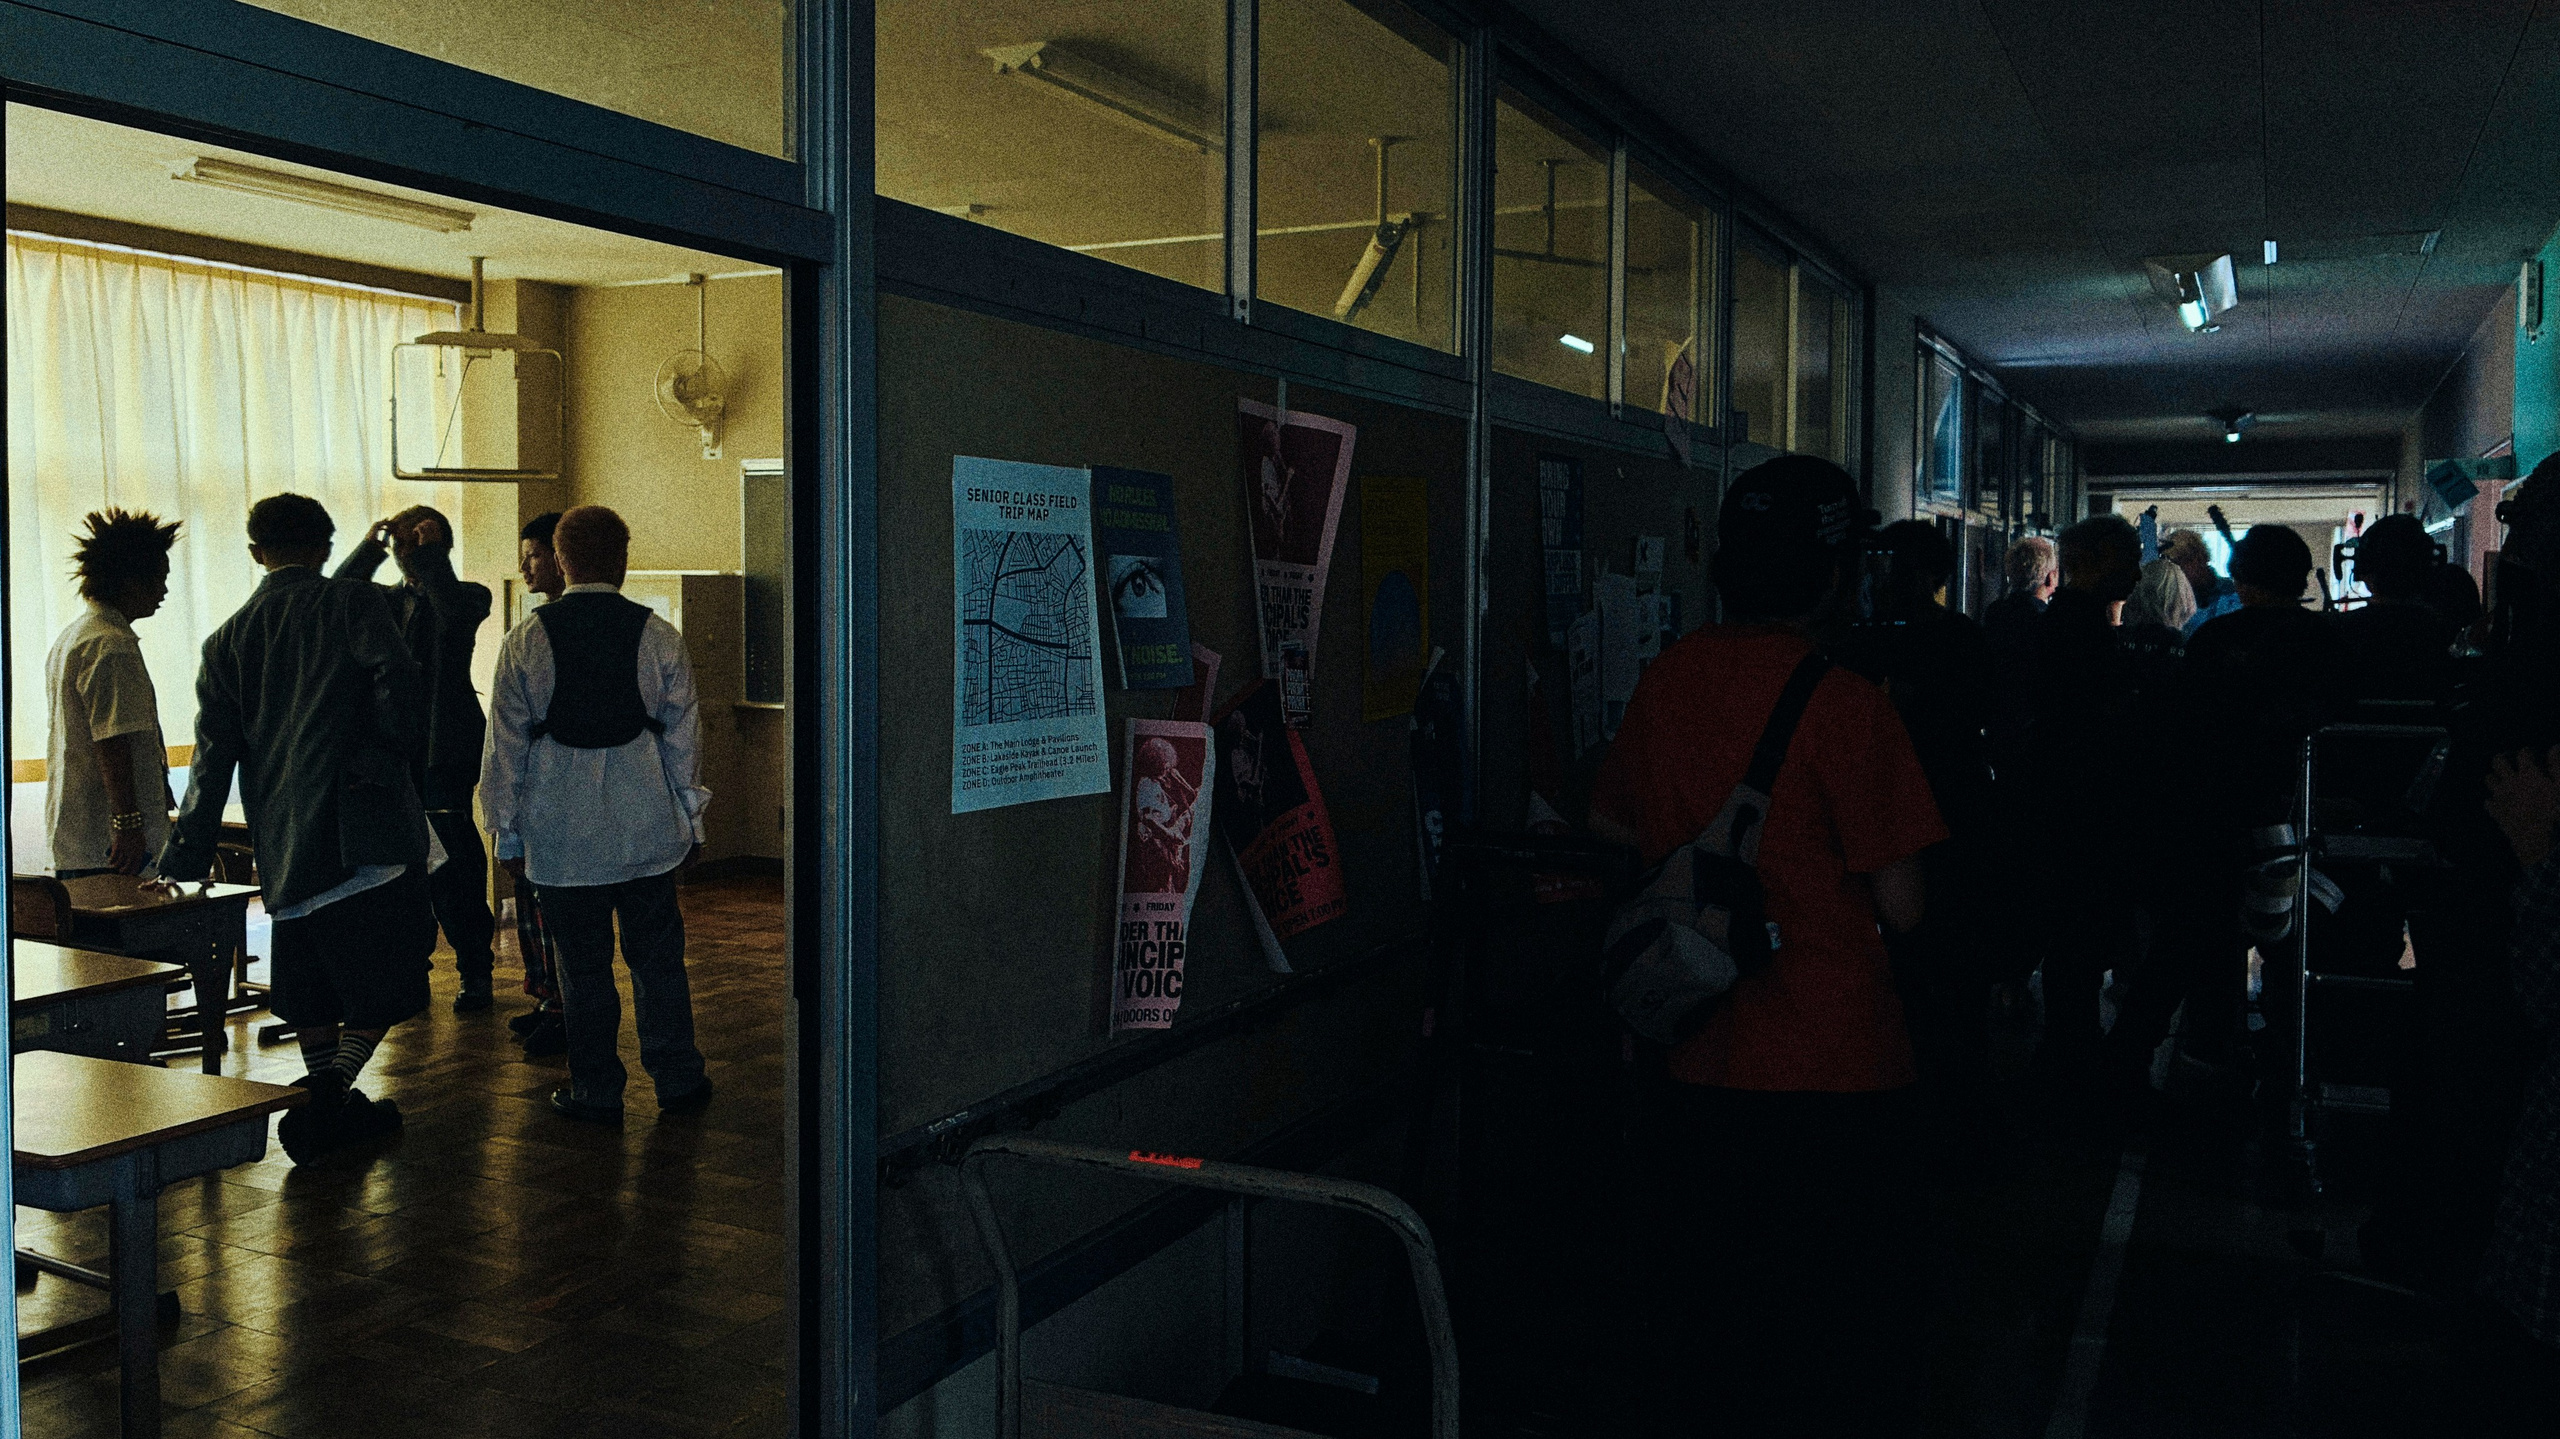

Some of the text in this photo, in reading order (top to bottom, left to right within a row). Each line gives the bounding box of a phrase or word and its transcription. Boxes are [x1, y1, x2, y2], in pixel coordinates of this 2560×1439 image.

[967, 488, 1077, 509] SENIOR CLASS FIELD
[999, 506, 1050, 521] TRIP MAP
[1294, 588, 1312, 605] THE
[1131, 643, 1184, 666] NOISE.
[962, 734, 1079, 753] ZONE A: The Main Lodge & Pavilions
[962, 742, 1098, 766] ZONE B: Lakeside Kayak & Canoe Launch
[962, 754, 1099, 778] ZONE C: Eagle Peak Trailhead (3.2 Miles)
[962, 769, 1065, 791] ZONE D: Outdoor Amphitheater
[1290, 825, 1323, 851] THE
[1146, 902, 1175, 911] FRIDAY
[1123, 970, 1182, 998] VOIC
